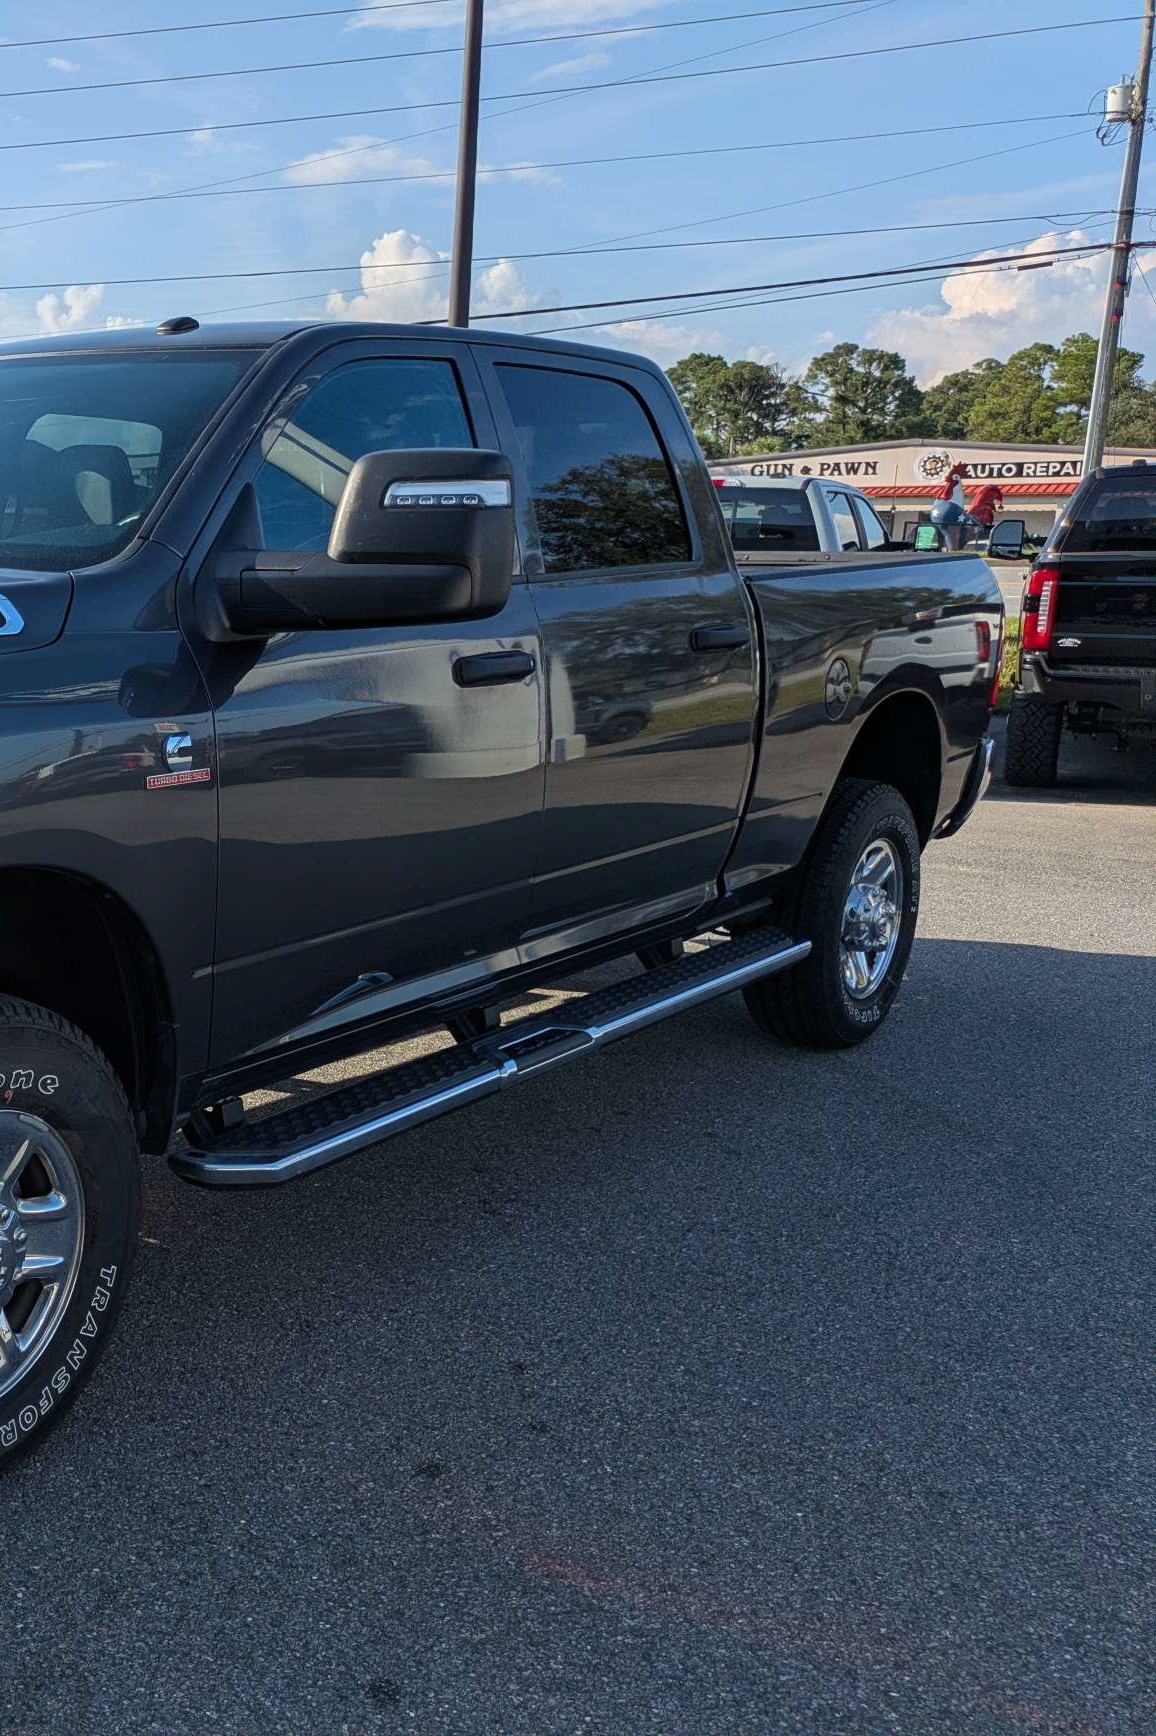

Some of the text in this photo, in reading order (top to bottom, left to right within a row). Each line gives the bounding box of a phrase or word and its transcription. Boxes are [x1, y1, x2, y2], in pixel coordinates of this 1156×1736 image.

[750, 461, 879, 478] GUN & PAWN
[965, 461, 1082, 478] AUTO REPAI
[149, 771, 210, 786] TURBO DIESEL
